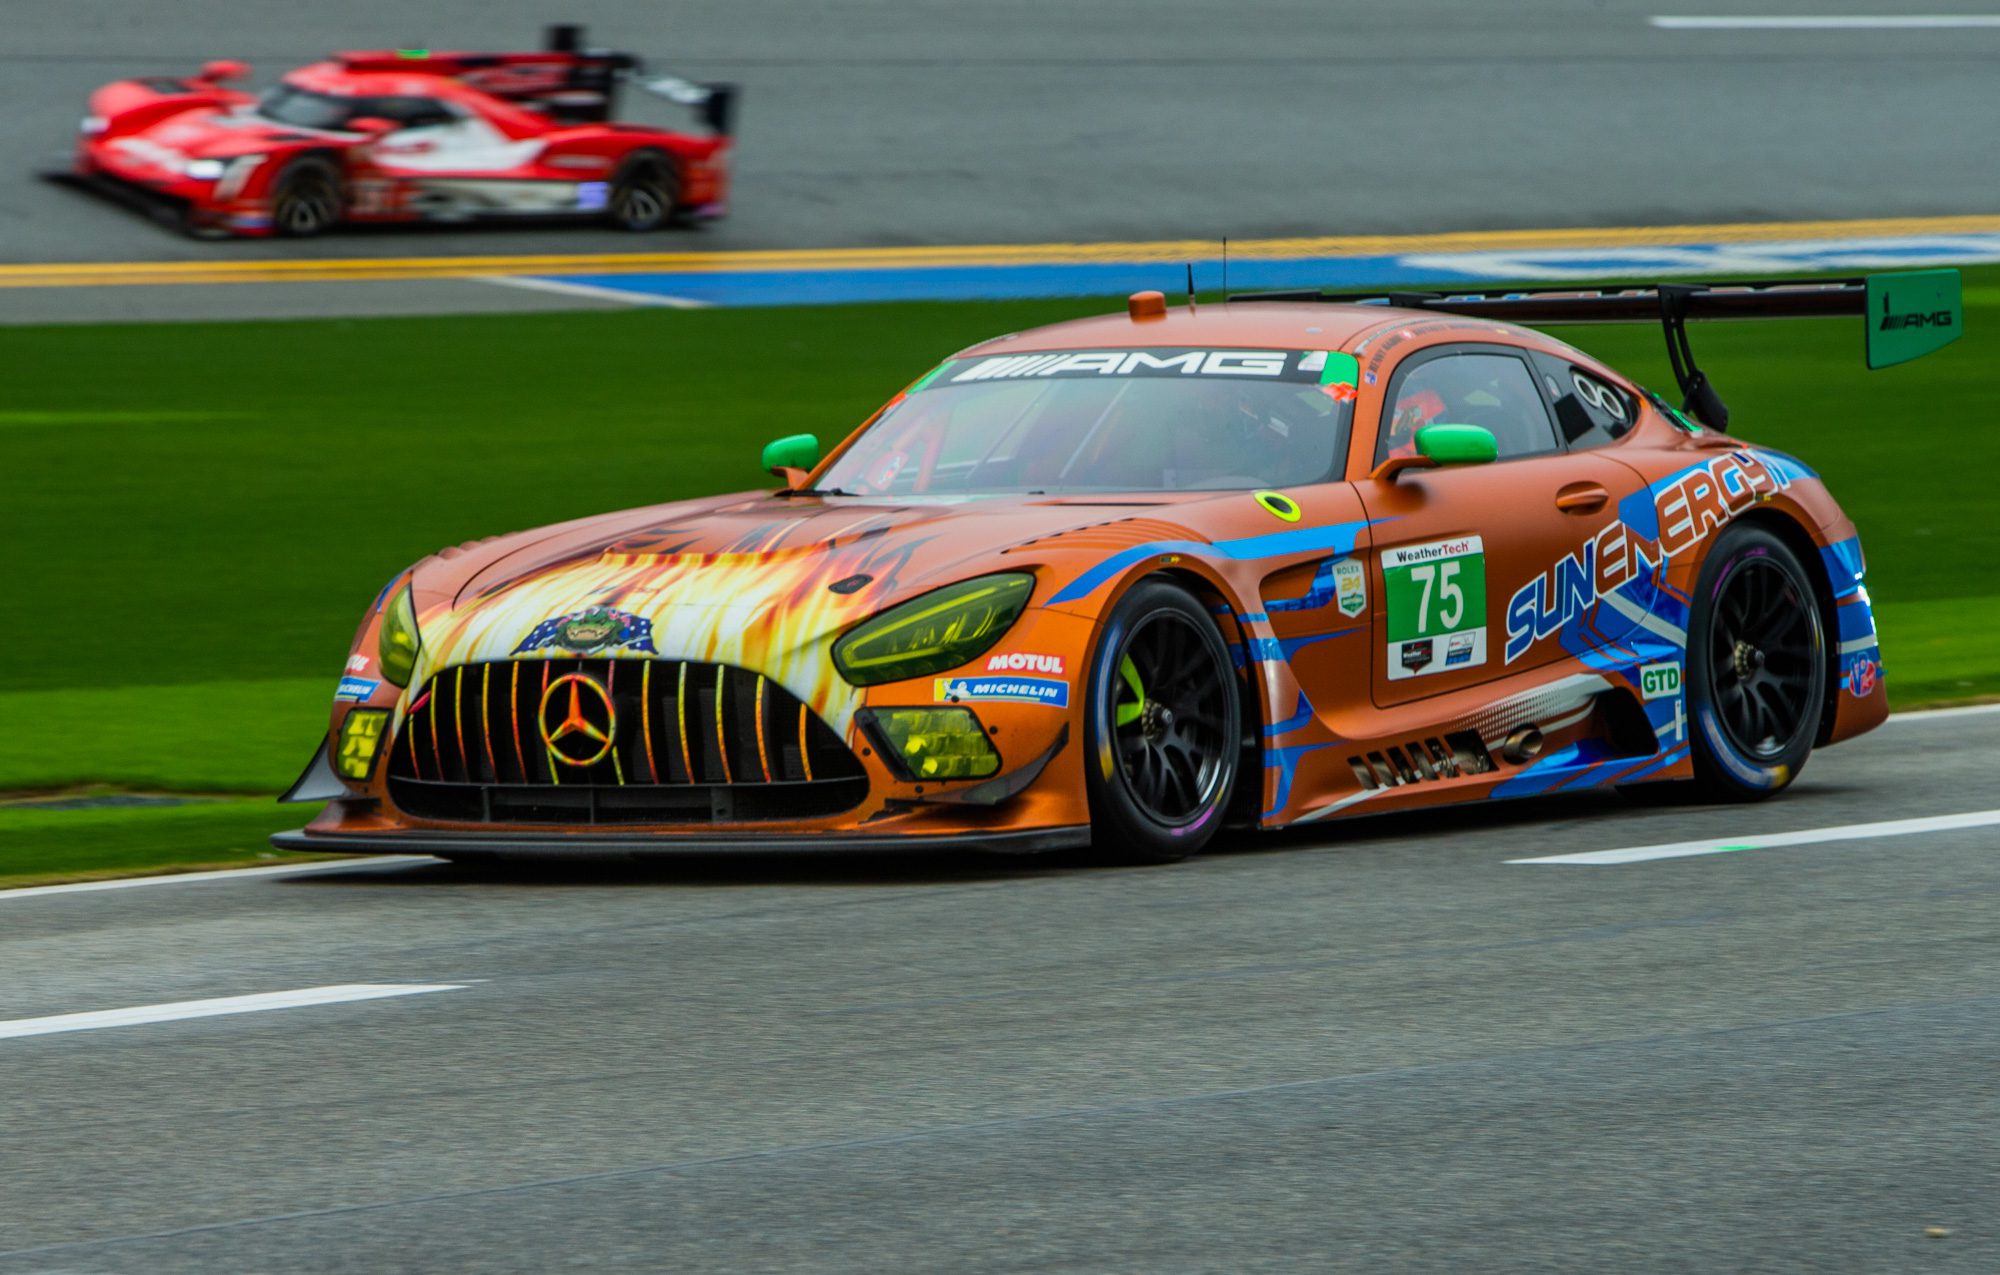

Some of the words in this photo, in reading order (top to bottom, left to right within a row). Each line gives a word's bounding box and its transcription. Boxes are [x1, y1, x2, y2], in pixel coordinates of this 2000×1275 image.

[1904, 310, 1952, 329] AMG
[1037, 351, 1288, 376] AMG
[1397, 542, 1469, 563] WeatherTech
[1342, 576, 1361, 592] 24
[1411, 561, 1464, 634] 75
[987, 653, 1063, 673] MOTUL
[1642, 667, 1680, 693] GTD
[973, 683, 1058, 698] MICHELIN
